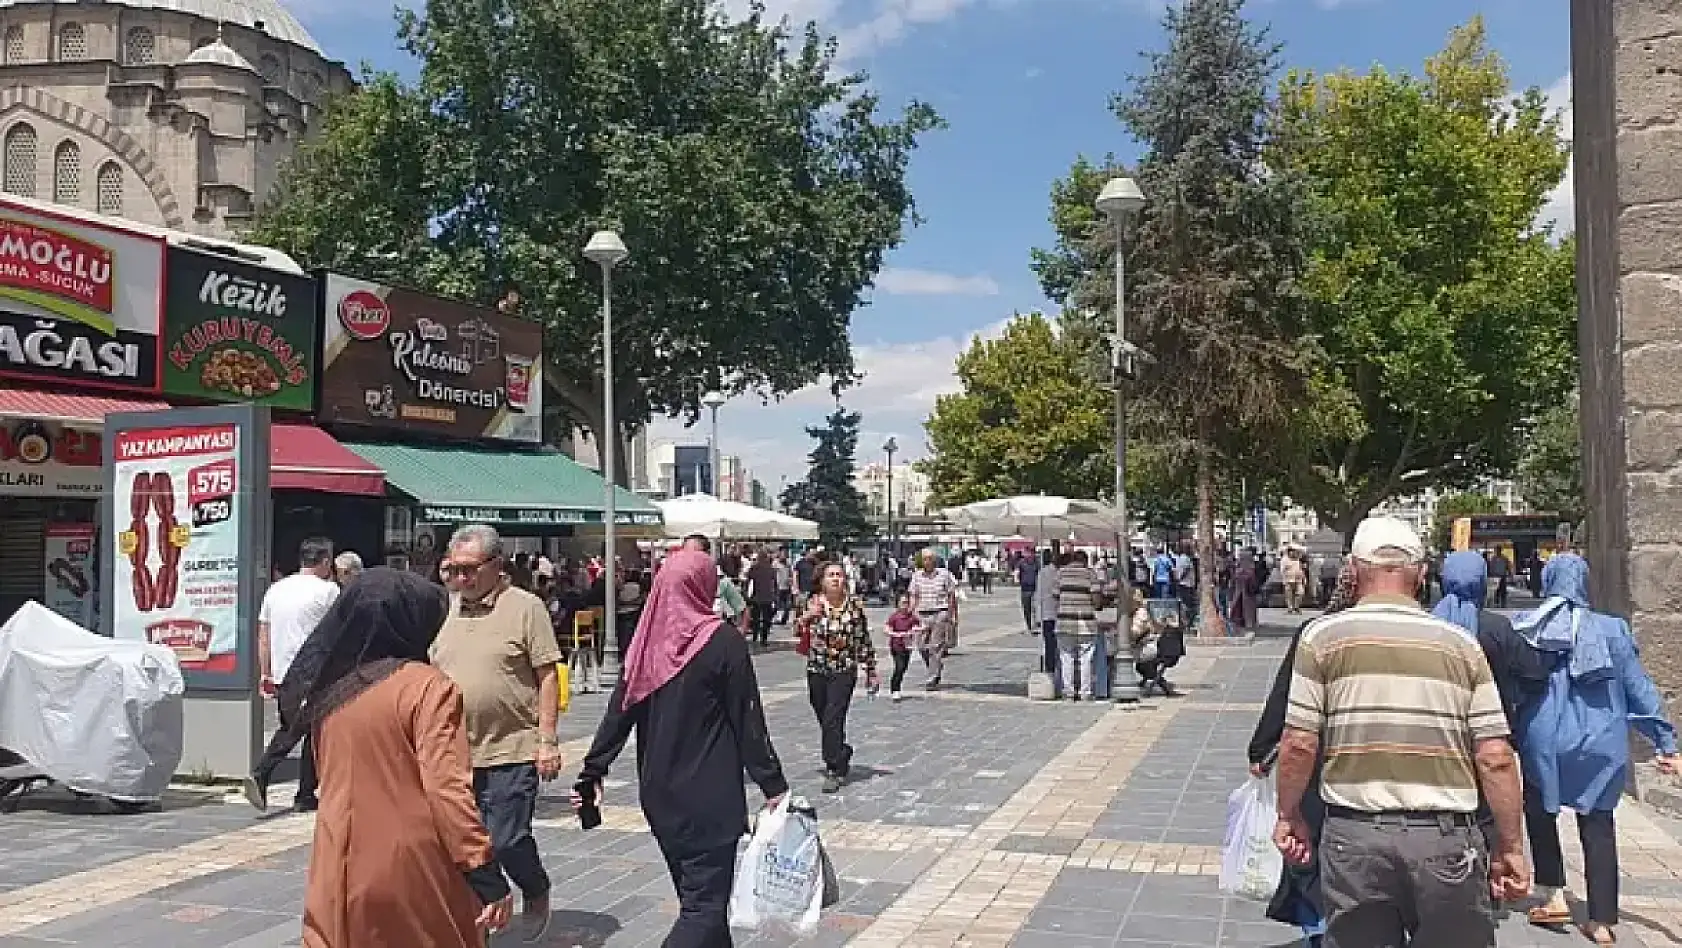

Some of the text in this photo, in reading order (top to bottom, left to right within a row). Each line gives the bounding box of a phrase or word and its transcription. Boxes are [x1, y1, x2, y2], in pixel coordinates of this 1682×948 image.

[0, 319, 139, 378] AĞASI
[121, 441, 145, 457] YAZ
[147, 431, 234, 454] KAMPANYASI
